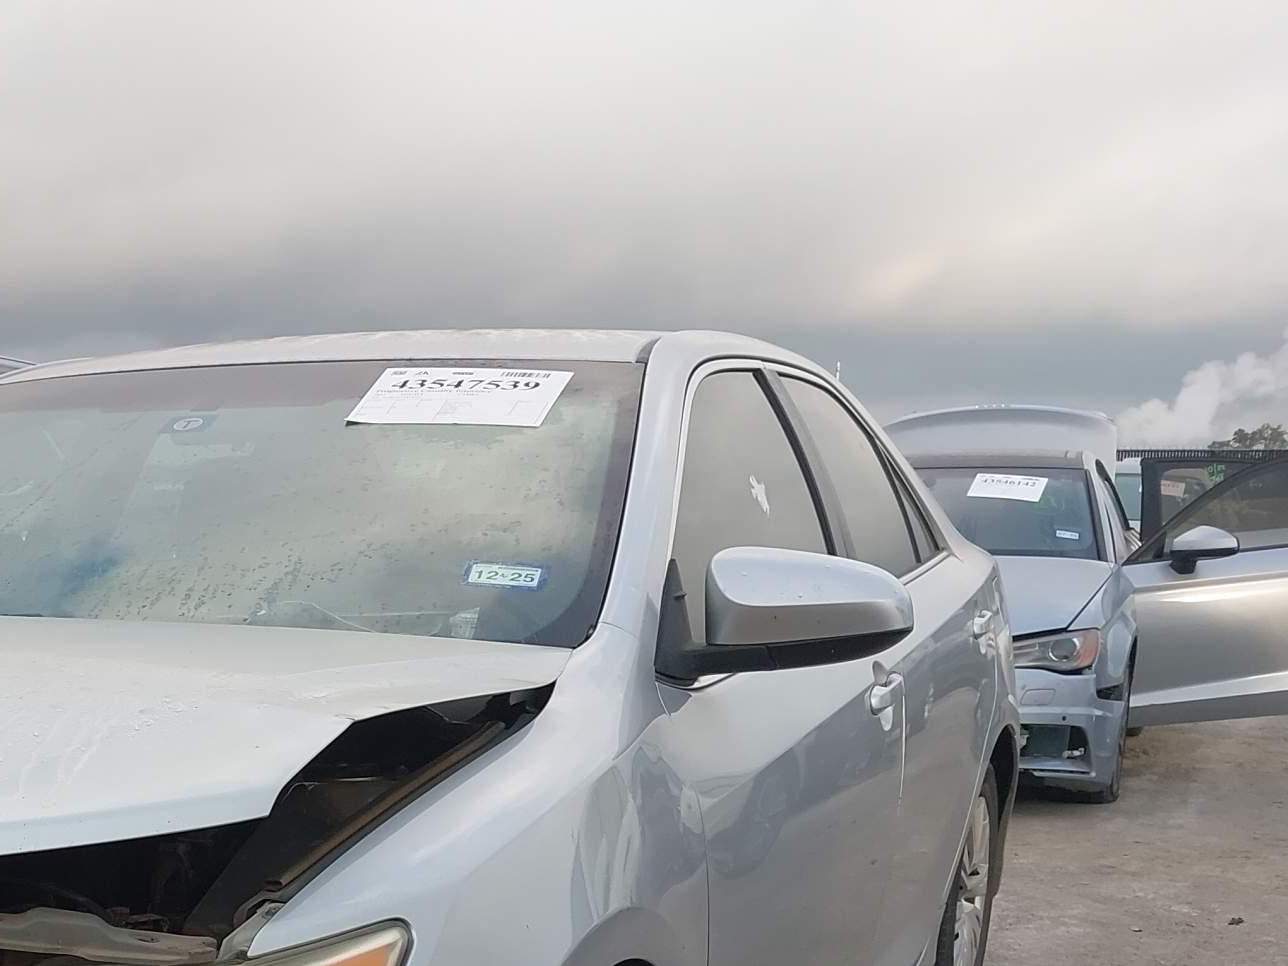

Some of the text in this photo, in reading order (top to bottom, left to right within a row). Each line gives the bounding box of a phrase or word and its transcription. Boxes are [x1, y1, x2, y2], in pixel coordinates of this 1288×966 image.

[392, 379, 540, 390] 43547539
[474, 569, 500, 581] 12
[509, 571, 537, 583] 25
